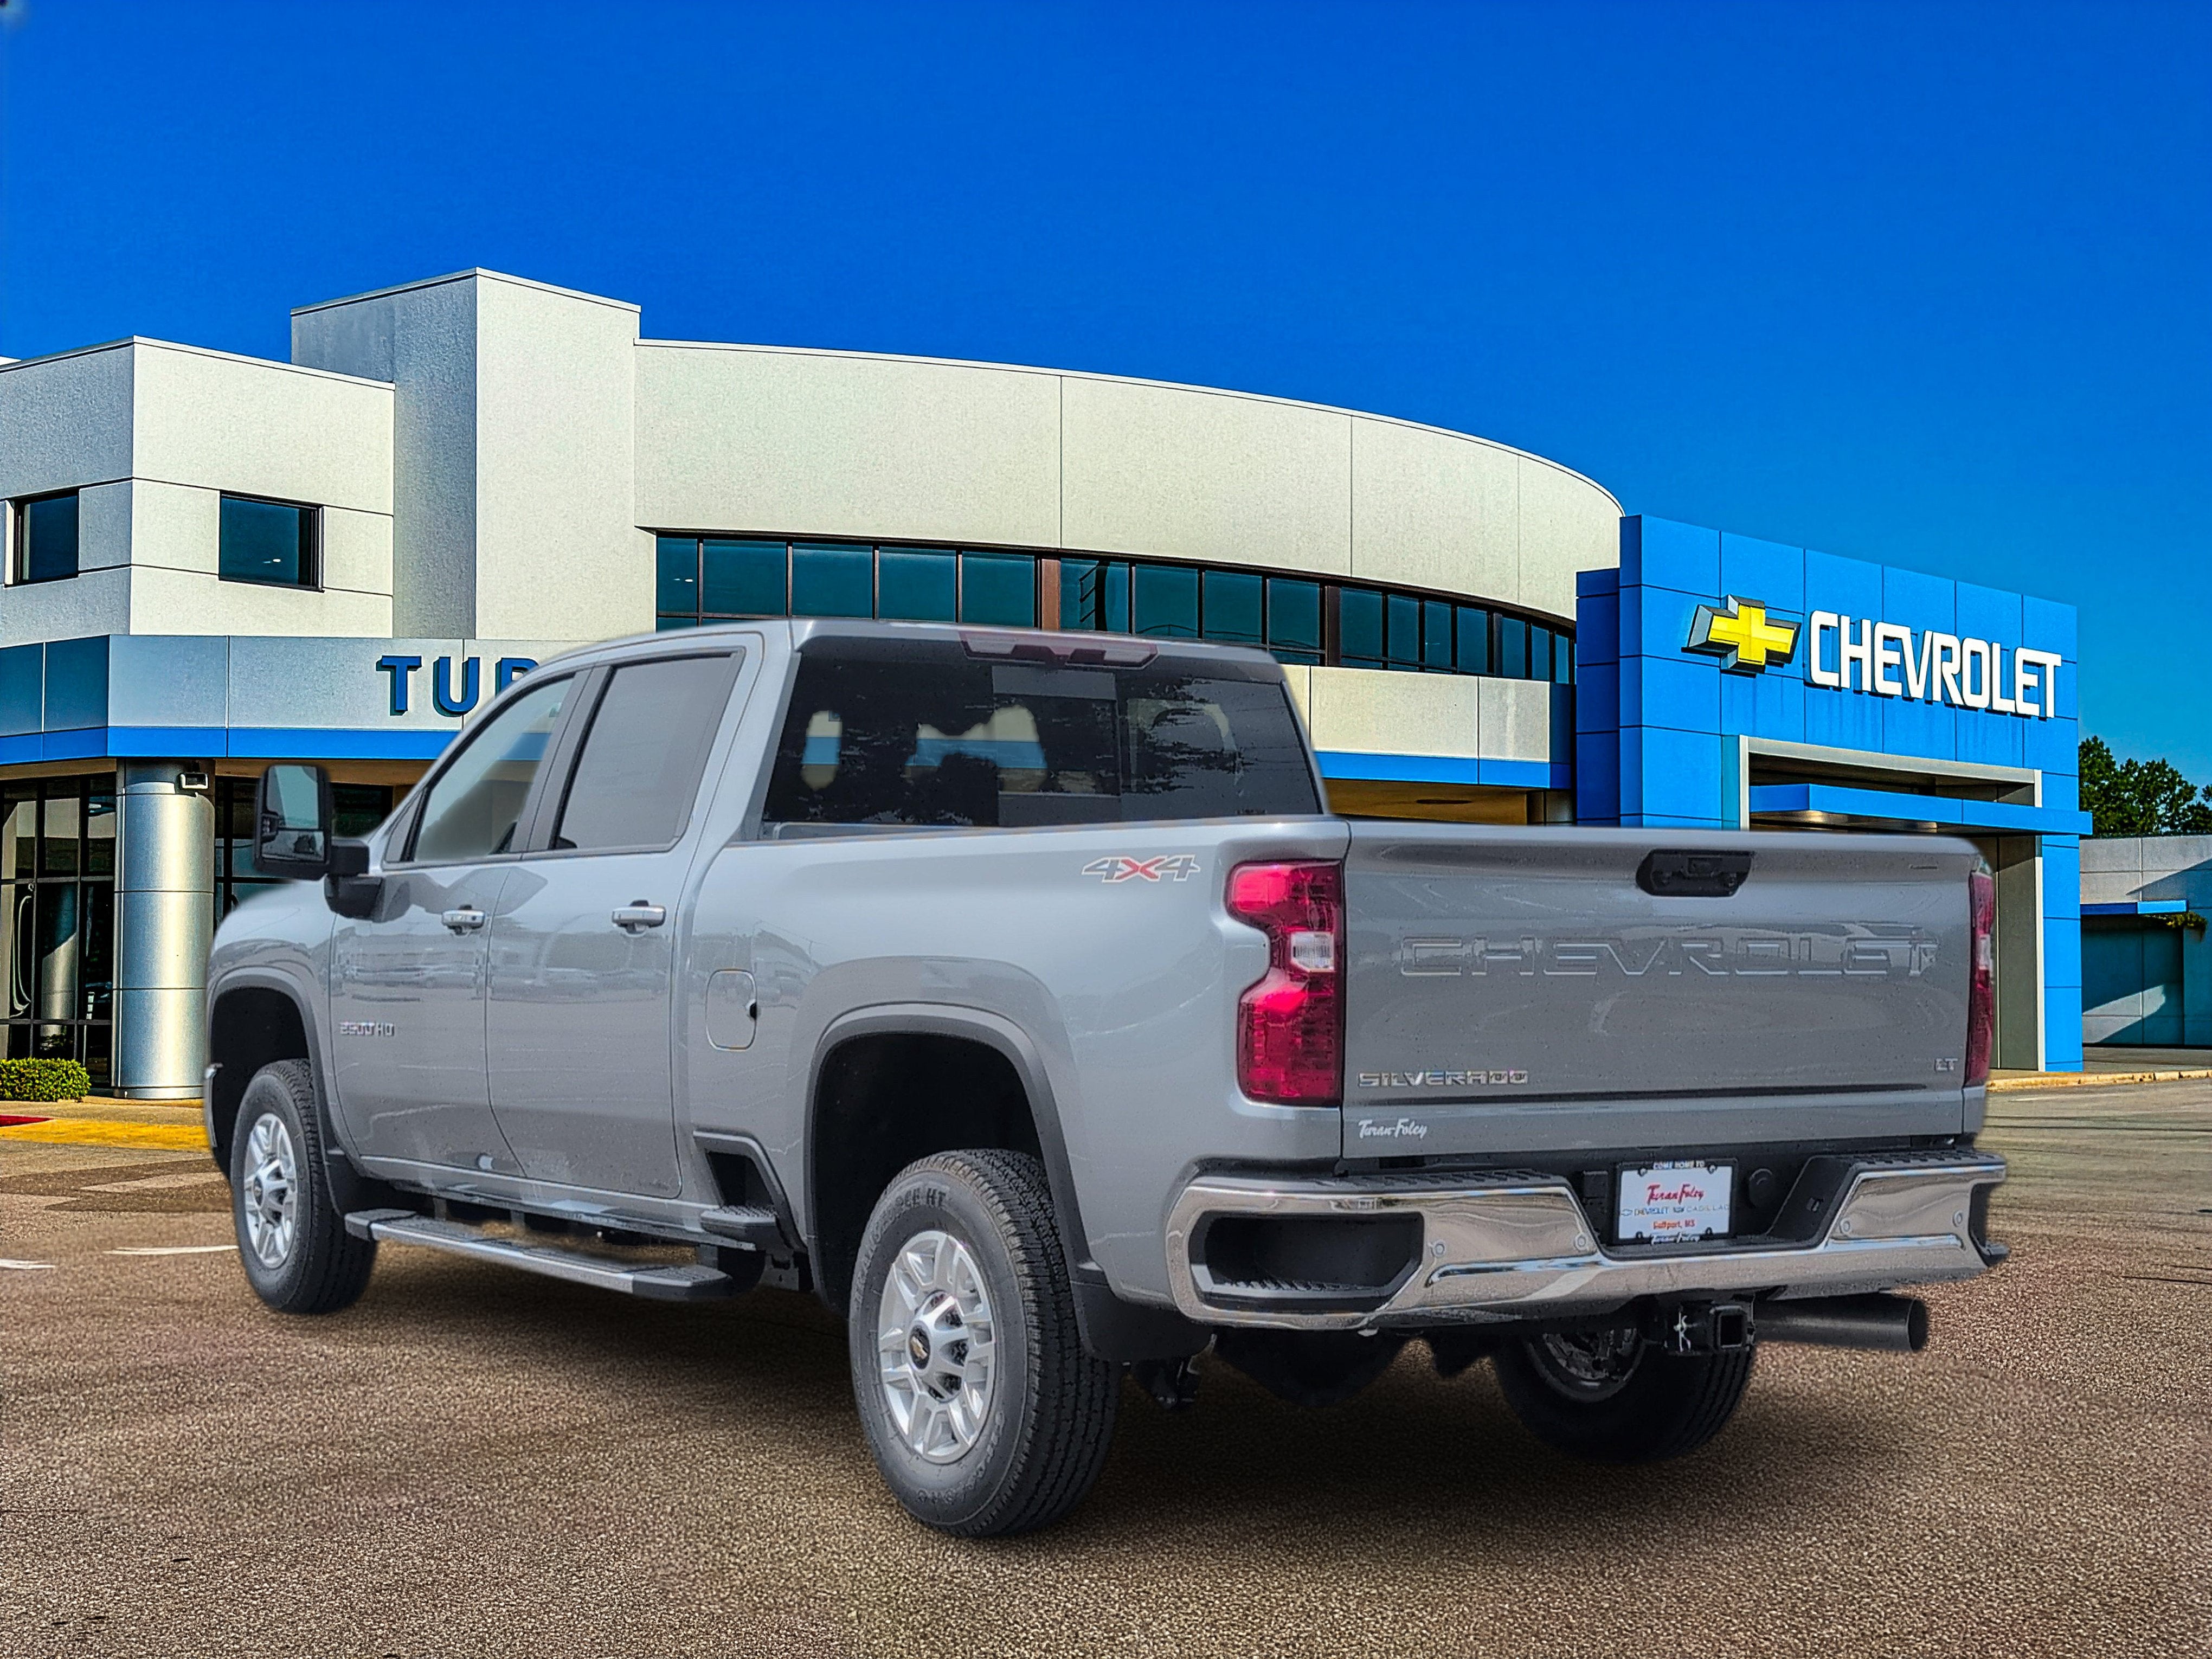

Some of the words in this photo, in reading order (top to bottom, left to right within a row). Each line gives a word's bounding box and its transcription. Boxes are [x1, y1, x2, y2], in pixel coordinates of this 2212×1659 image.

[1810, 610, 2062, 718] CHEVROLET
[1401, 936, 1939, 976] CHEVROLET
[1935, 1058, 1958, 1071] LT
[1359, 1070, 1528, 1087] SILVERADO
[1394, 1118, 1427, 1139] Foley
